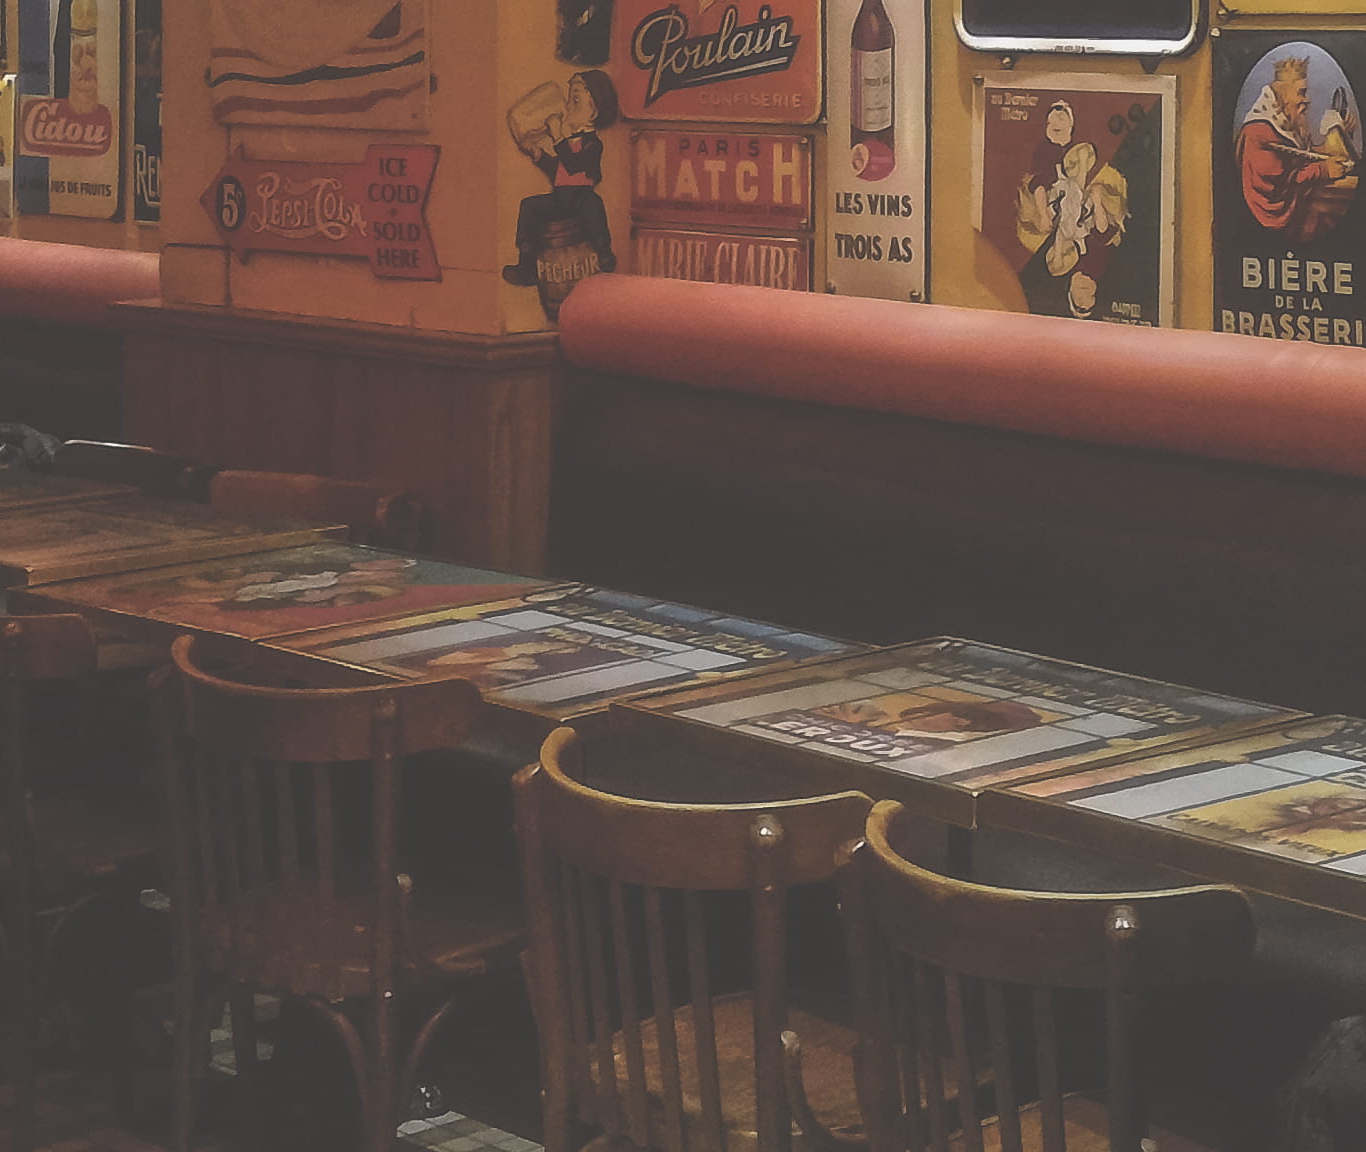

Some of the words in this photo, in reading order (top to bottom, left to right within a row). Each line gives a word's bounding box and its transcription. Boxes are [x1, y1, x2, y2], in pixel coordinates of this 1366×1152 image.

[635, 8, 794, 98] Poulain
[698, 91, 804, 110] CONFISERIE
[24, 101, 110, 147] Cidou
[678, 138, 761, 158] PARIS
[378, 157, 407, 177] ICE
[637, 138, 802, 205] MATCH
[51, 181, 65, 194] JUS
[67, 182, 79, 194] DE
[81, 183, 112, 197] FRUITS
[368, 182, 420, 204] COLD
[835, 191, 864, 215] LES
[866, 194, 913, 218] VINS
[373, 221, 421, 242] SOLD
[835, 233, 883, 260] TROIS
[887, 236, 913, 262] AS
[376, 249, 421, 269] HERE
[1243, 252, 1354, 296] BIÈRE
[1275, 296, 1295, 311] DE
[1303, 297, 1322, 312] LA
